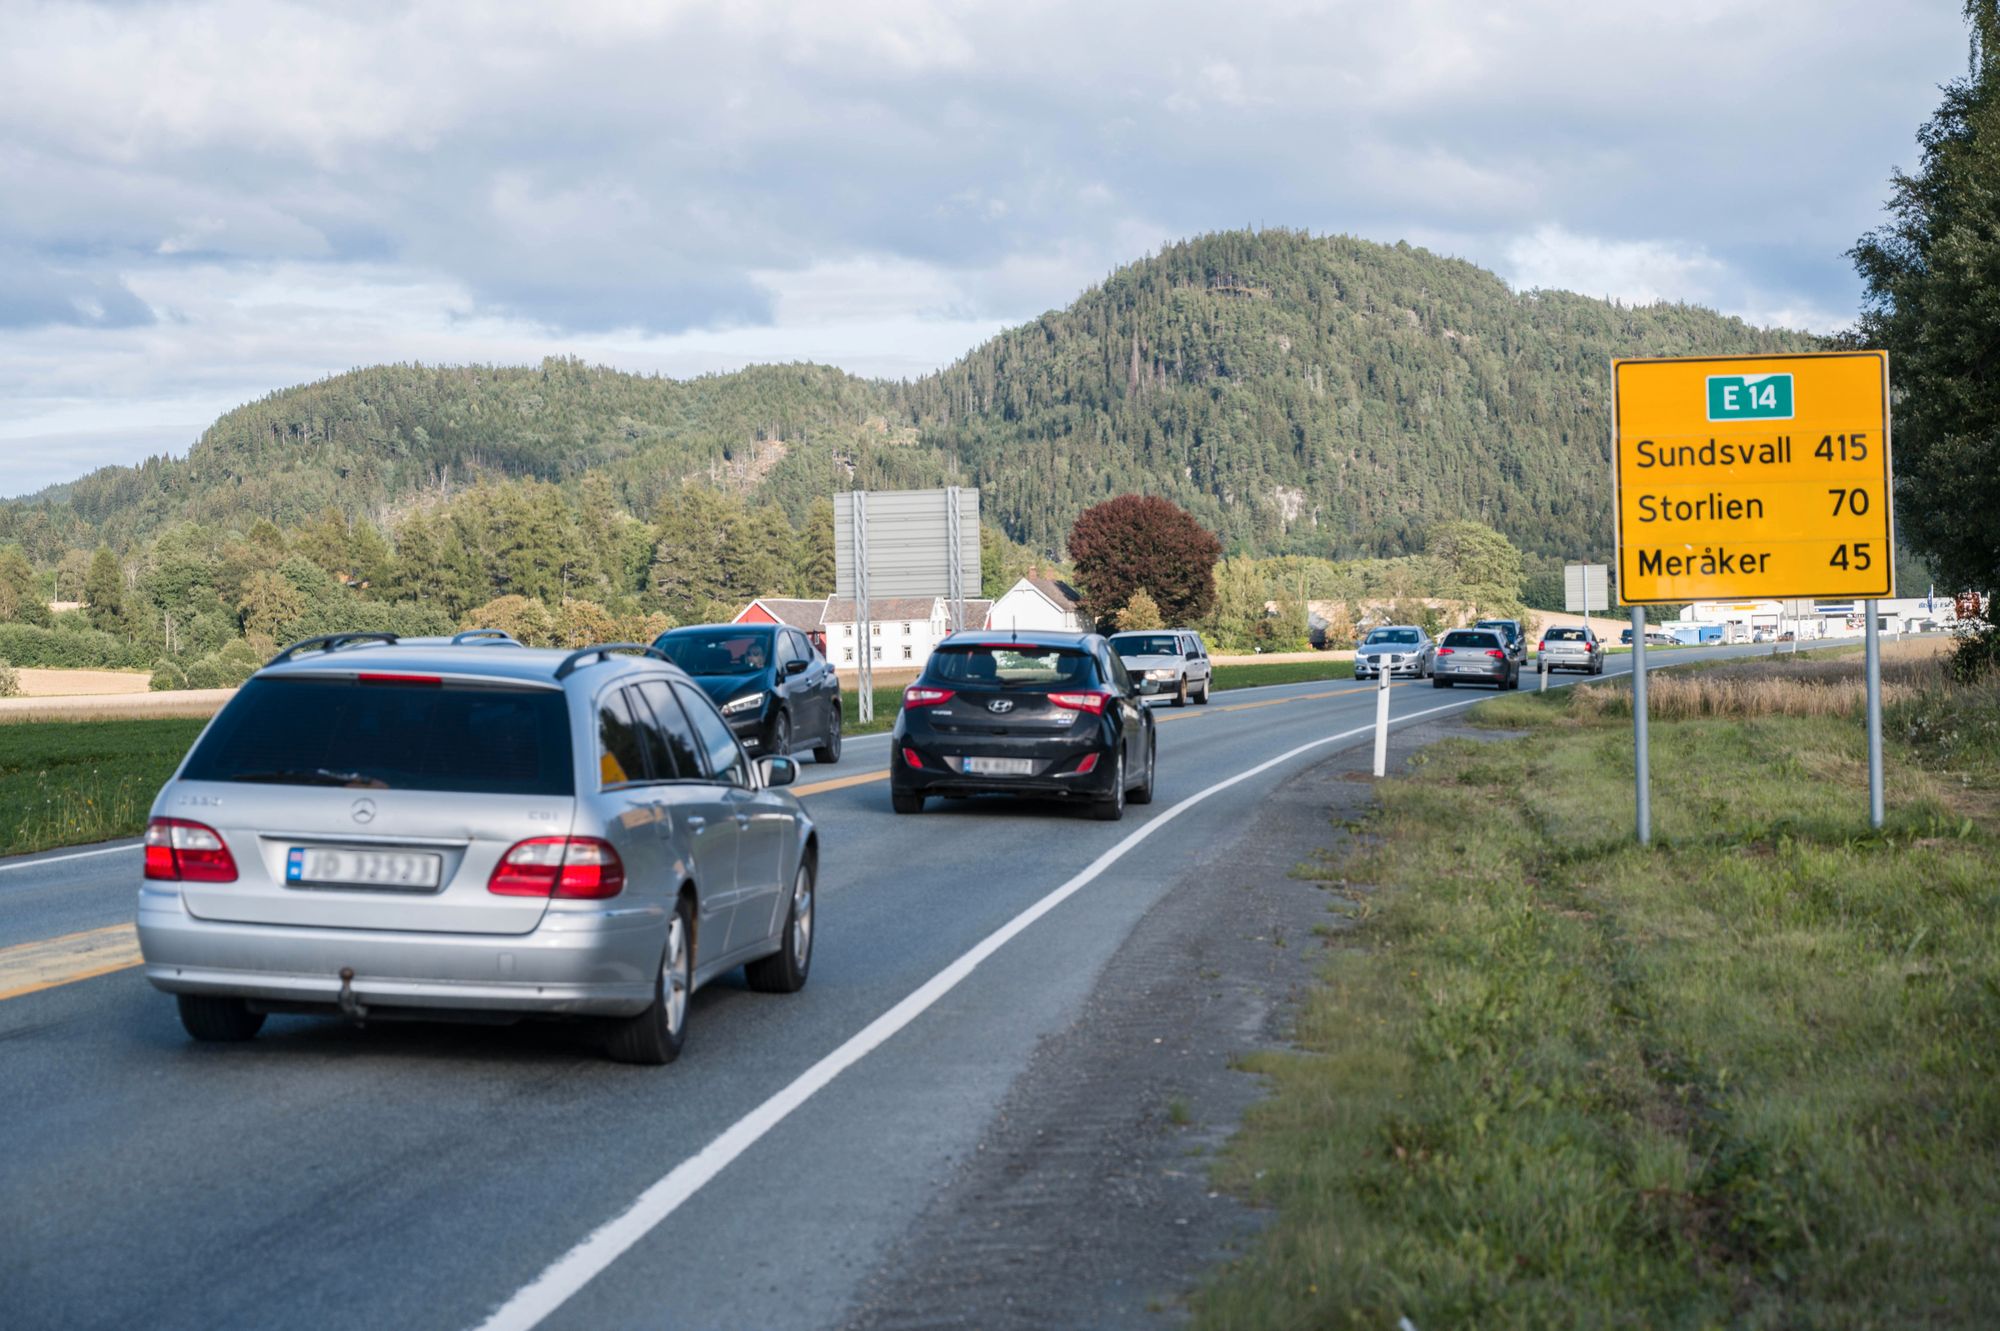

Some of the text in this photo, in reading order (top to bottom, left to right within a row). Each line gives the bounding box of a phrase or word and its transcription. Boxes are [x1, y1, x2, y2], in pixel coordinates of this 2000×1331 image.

[1723, 384, 1777, 411] E 14
[1636, 433, 1868, 468] Sundsvall 415
[1638, 487, 1870, 523] Storlien 70
[1638, 542, 1872, 577] Meråker 45
